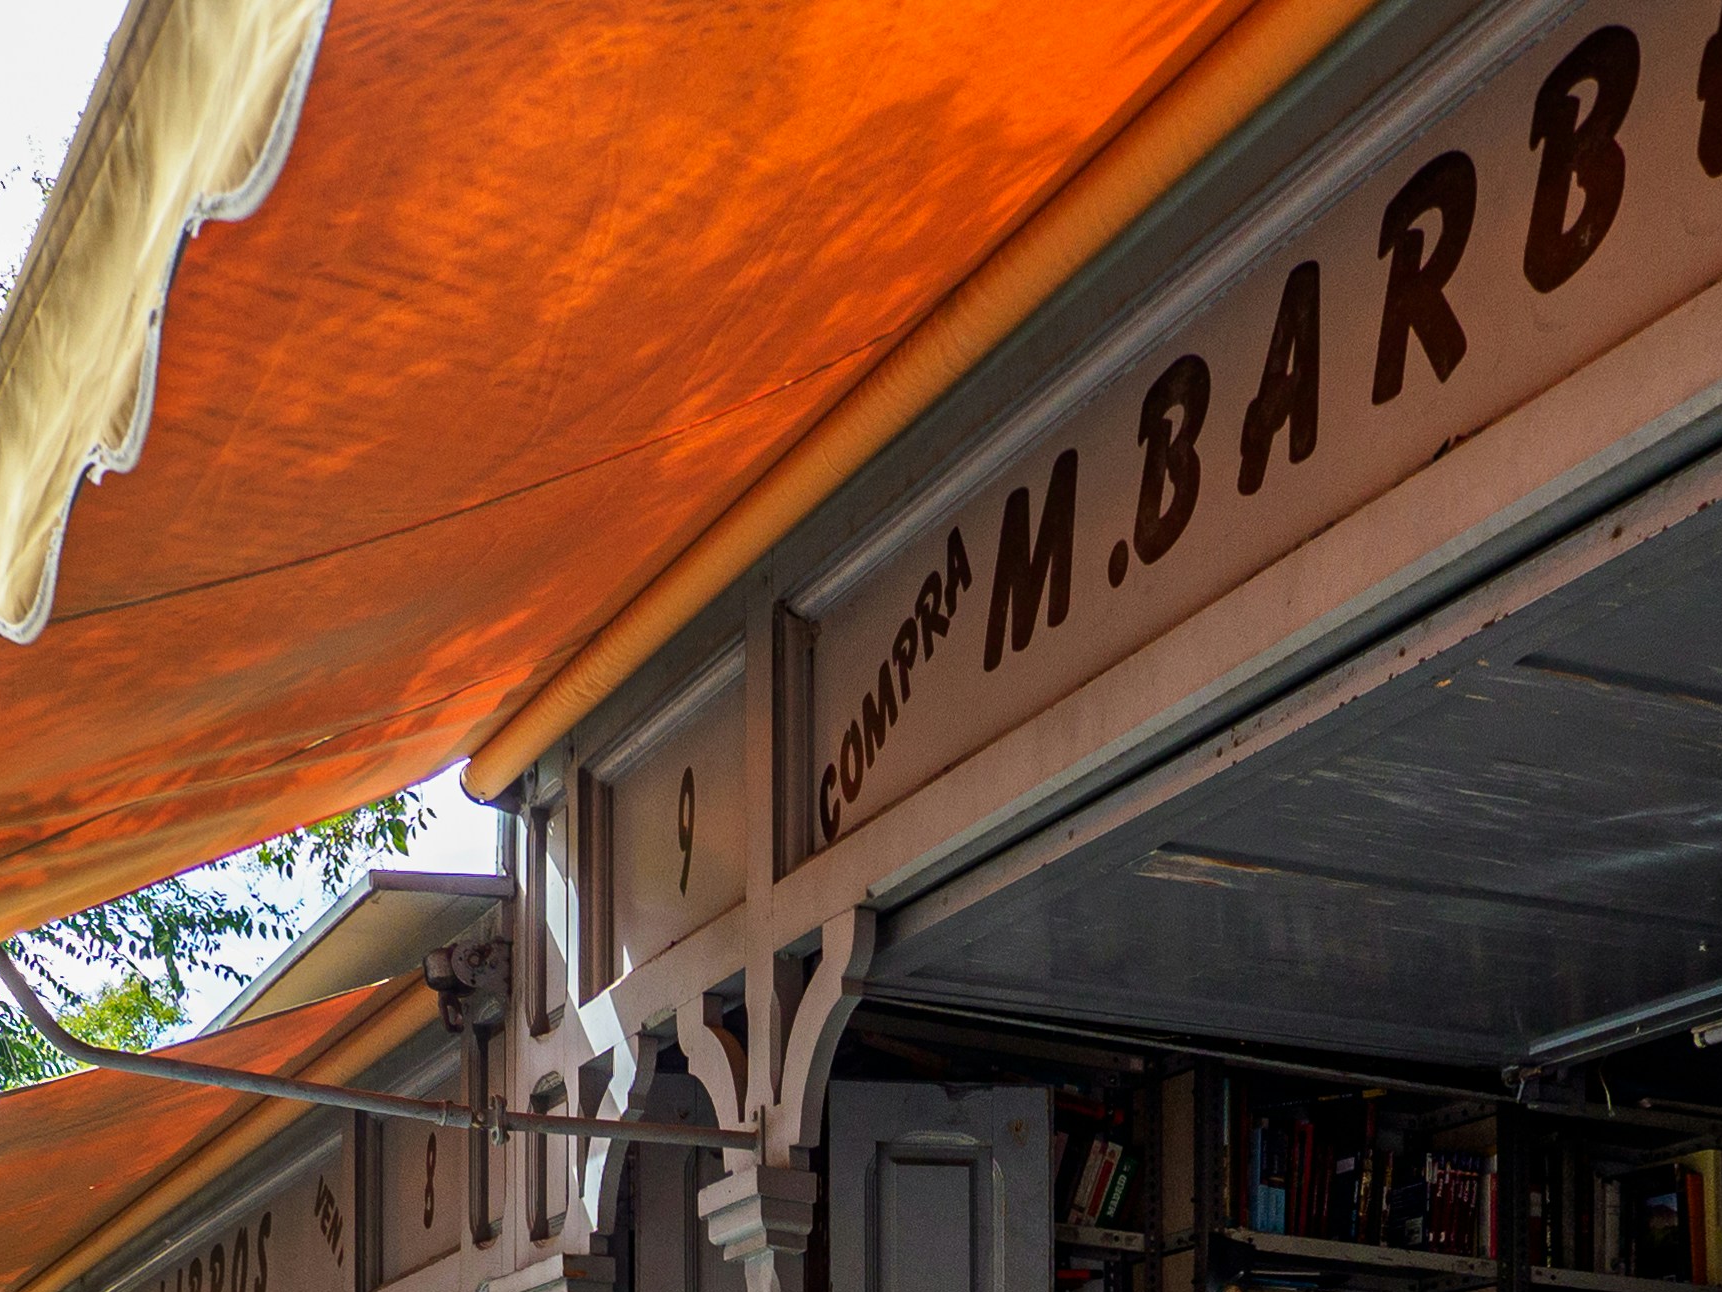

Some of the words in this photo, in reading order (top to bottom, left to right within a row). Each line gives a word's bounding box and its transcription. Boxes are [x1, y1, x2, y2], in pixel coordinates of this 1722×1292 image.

[817, 525, 973, 845] COMPRA
[677, 765, 696, 898] 9
[424, 1133, 437, 1230] 8
